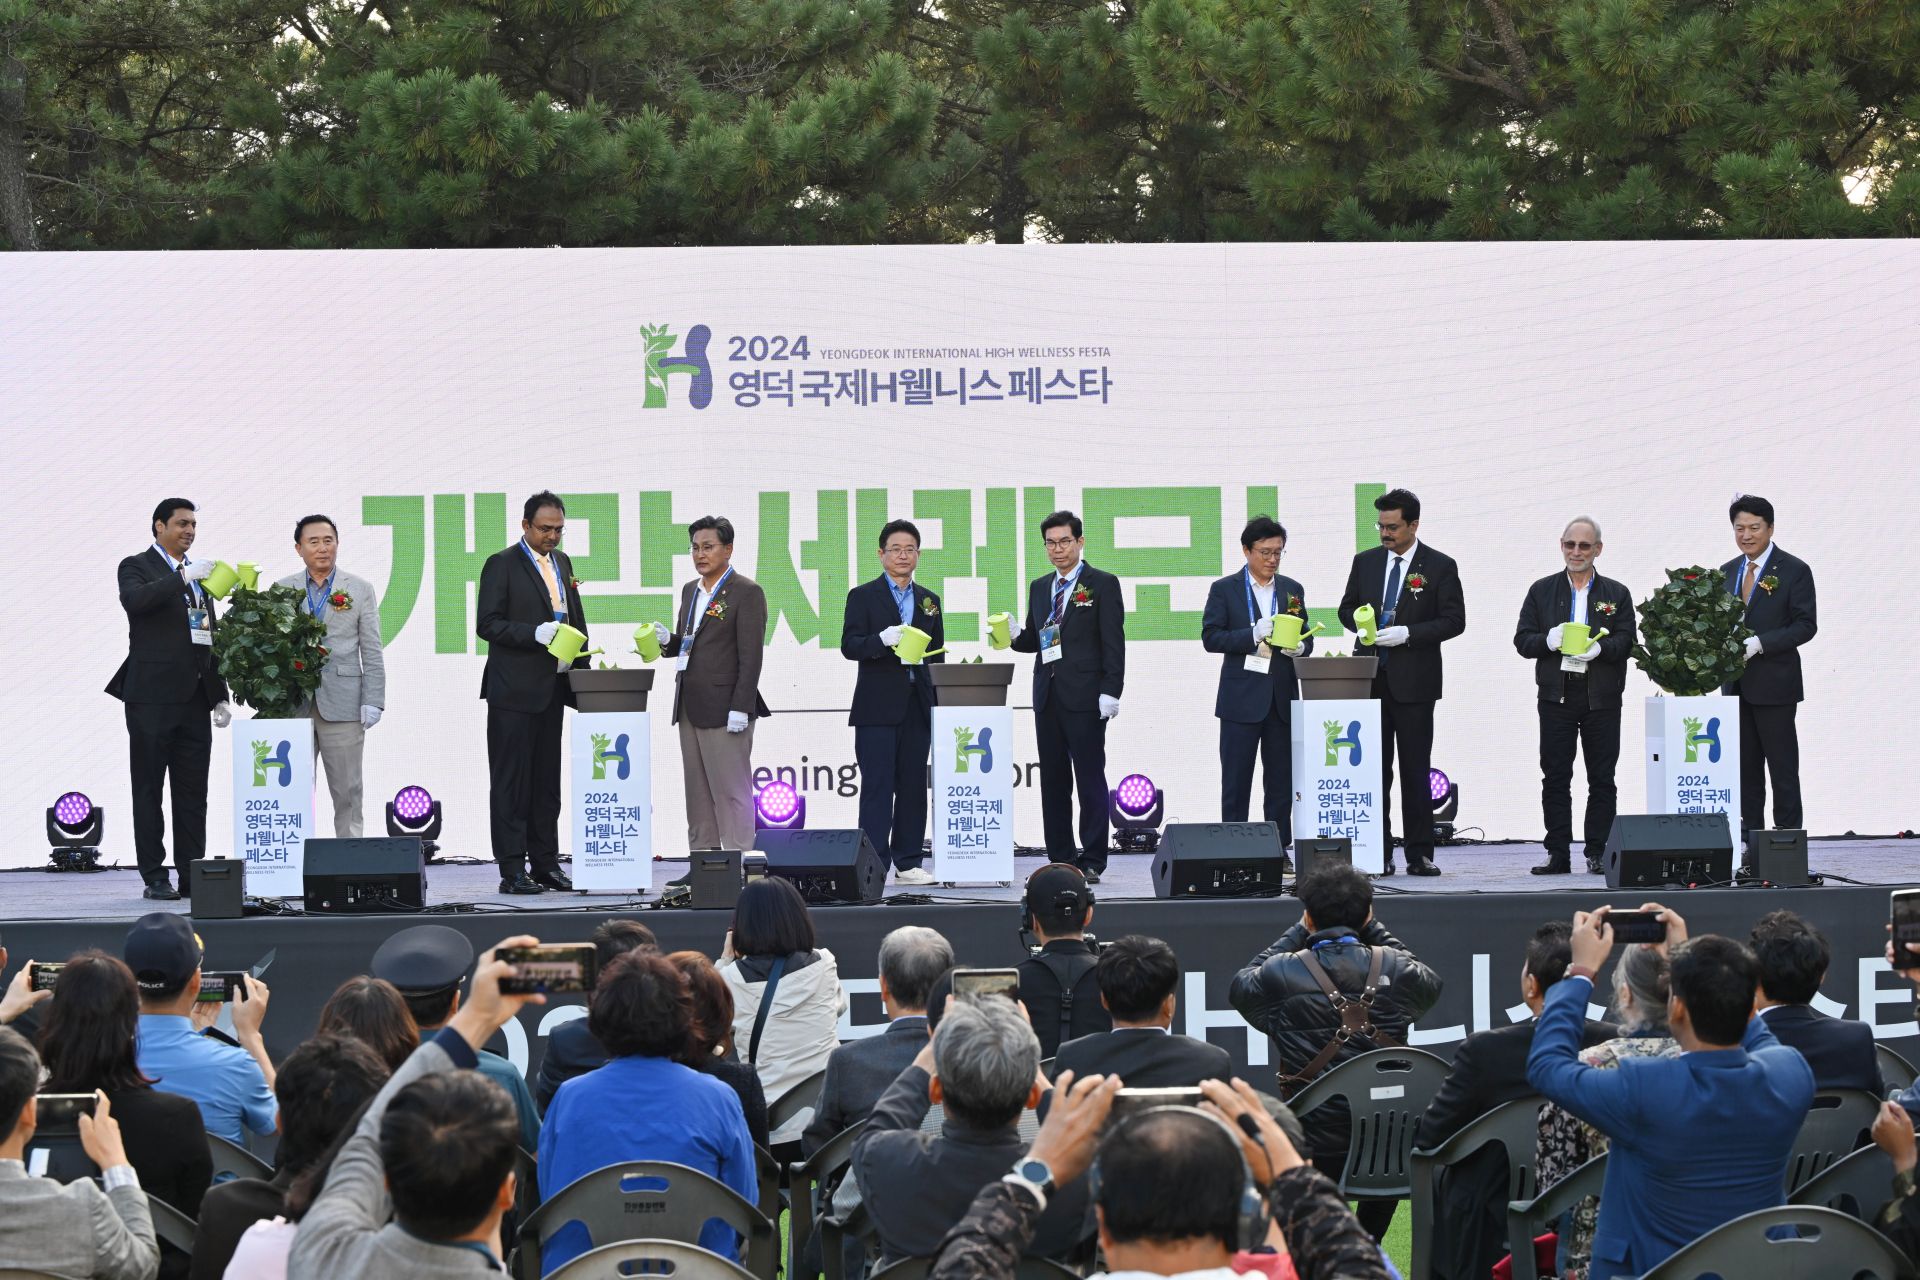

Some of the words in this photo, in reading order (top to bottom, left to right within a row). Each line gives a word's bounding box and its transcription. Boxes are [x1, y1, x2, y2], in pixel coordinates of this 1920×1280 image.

[728, 335, 811, 362] 2024
[819, 347, 891, 360] YEONGDEOK
[893, 347, 982, 360] INTERNATIONAL
[985, 346, 1015, 359] HIGH
[1018, 346, 1076, 359] WELLNESS
[1078, 346, 1112, 358] FESTA
[728, 366, 794, 408] 영덕
[1317, 778, 1351, 790] 2024
[1677, 775, 1710, 787] 2024
[584, 792, 619, 804] 2024
[947, 785, 981, 797] 2024
[1677, 788, 1703, 805] 영덕
[1704, 788, 1731, 804] 국제
[245, 799, 280, 811] 2024
[947, 799, 974, 815] 영덕
[975, 799, 1003, 815] 국제
[1317, 792, 1344, 808] 영덕
[1345, 791, 1372, 808] 국제
[245, 813, 272, 829] 영덕
[273, 812, 302, 829] 국제
[584, 806, 611, 822] 영덕
[612, 806, 641, 822] 국제
[1318, 809, 1371, 825] H웰니스
[585, 823, 639, 839] H웰니스
[947, 816, 1001, 832] H웰니스
[245, 830, 300, 846] H웰니스
[947, 833, 990, 849] 페스타
[245, 847, 289, 864] 페스타
[584, 839, 628, 856] 페스타
